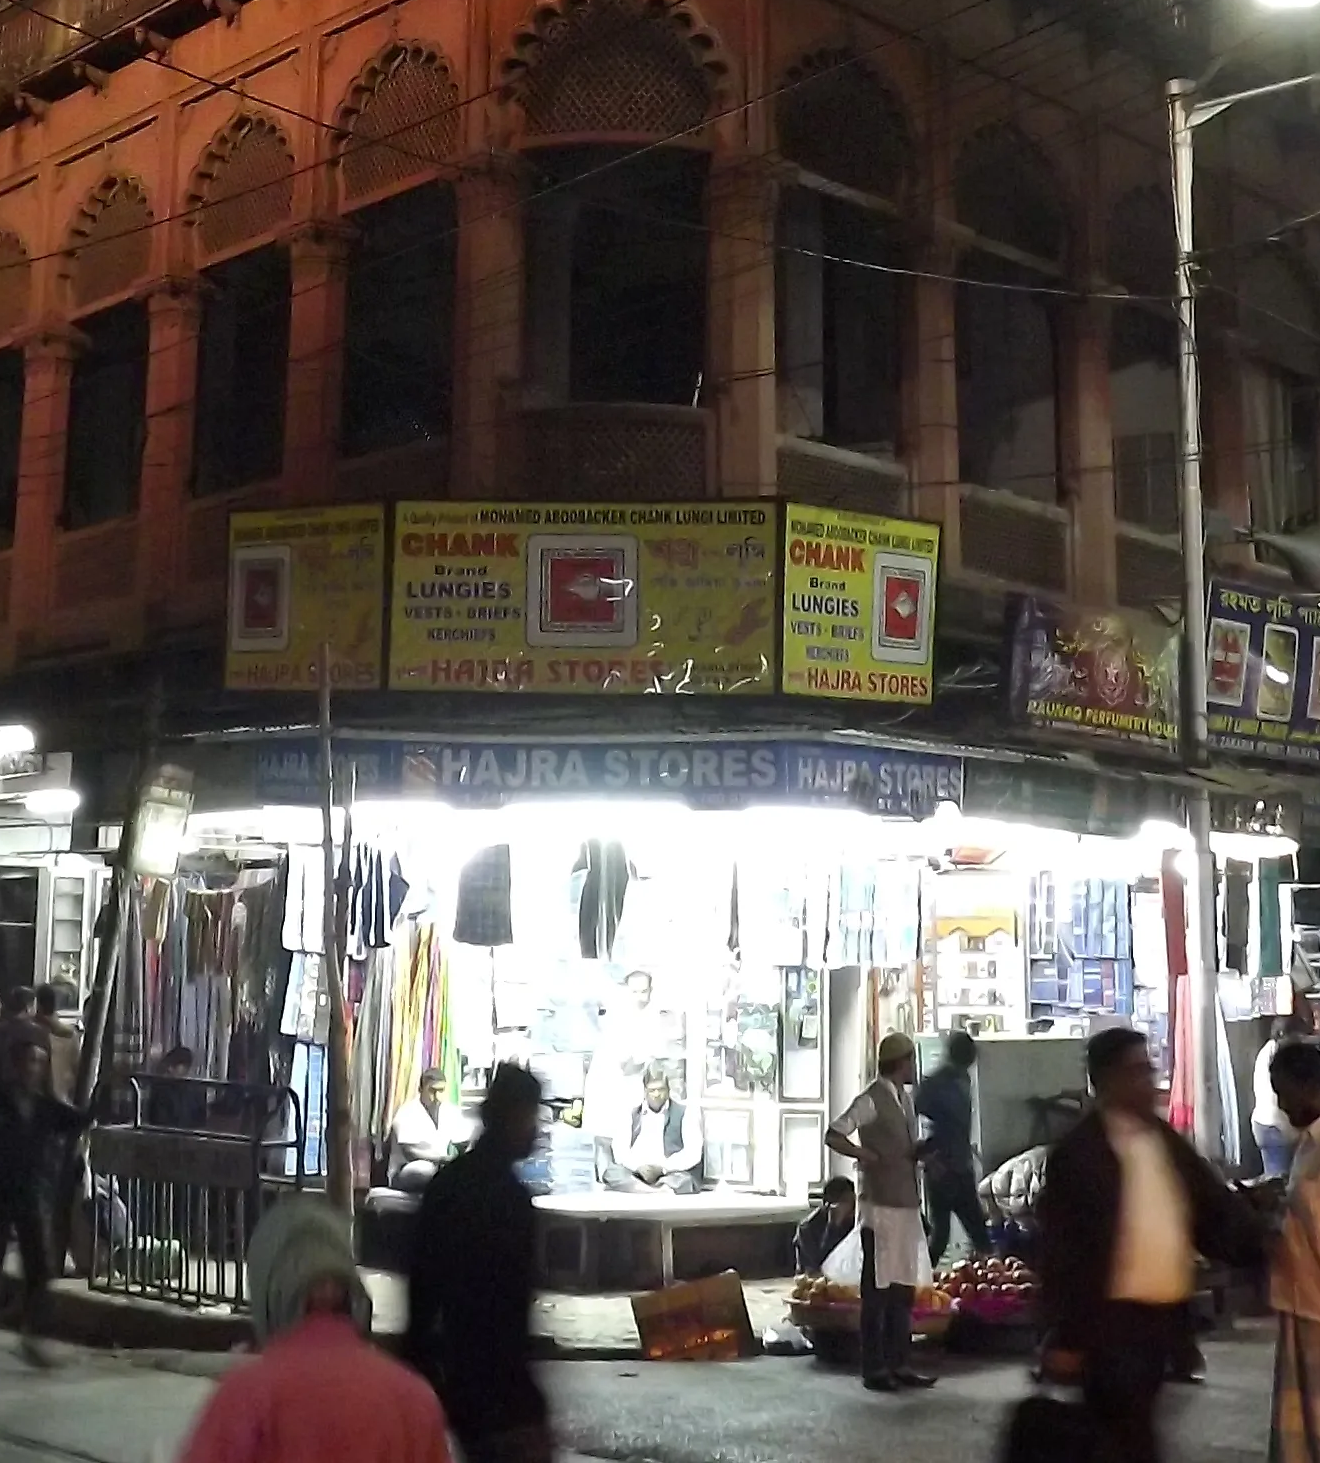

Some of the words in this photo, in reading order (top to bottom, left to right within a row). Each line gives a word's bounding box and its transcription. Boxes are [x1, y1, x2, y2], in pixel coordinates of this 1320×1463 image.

[630, 509, 672, 524] CHANK
[676, 510, 713, 524] LUNGI
[717, 510, 766, 524] LIMITED
[400, 533, 521, 558] CHANK
[789, 539, 865, 572] CHANK
[434, 564, 489, 577] Brand
[406, 581, 513, 599] LUNGIES
[810, 577, 846, 592] Brand
[404, 606, 453, 620] VESTS
[466, 607, 523, 620] BRIEFS
[791, 592, 860, 618] LUNGIES
[790, 620, 822, 637] VESTS
[807, 666, 861, 693] HAJRA
[867, 671, 928, 698] STORES
[441, 747, 593, 787] HAJRA
[606, 748, 777, 788] STORES
[879, 761, 961, 799] STORES
